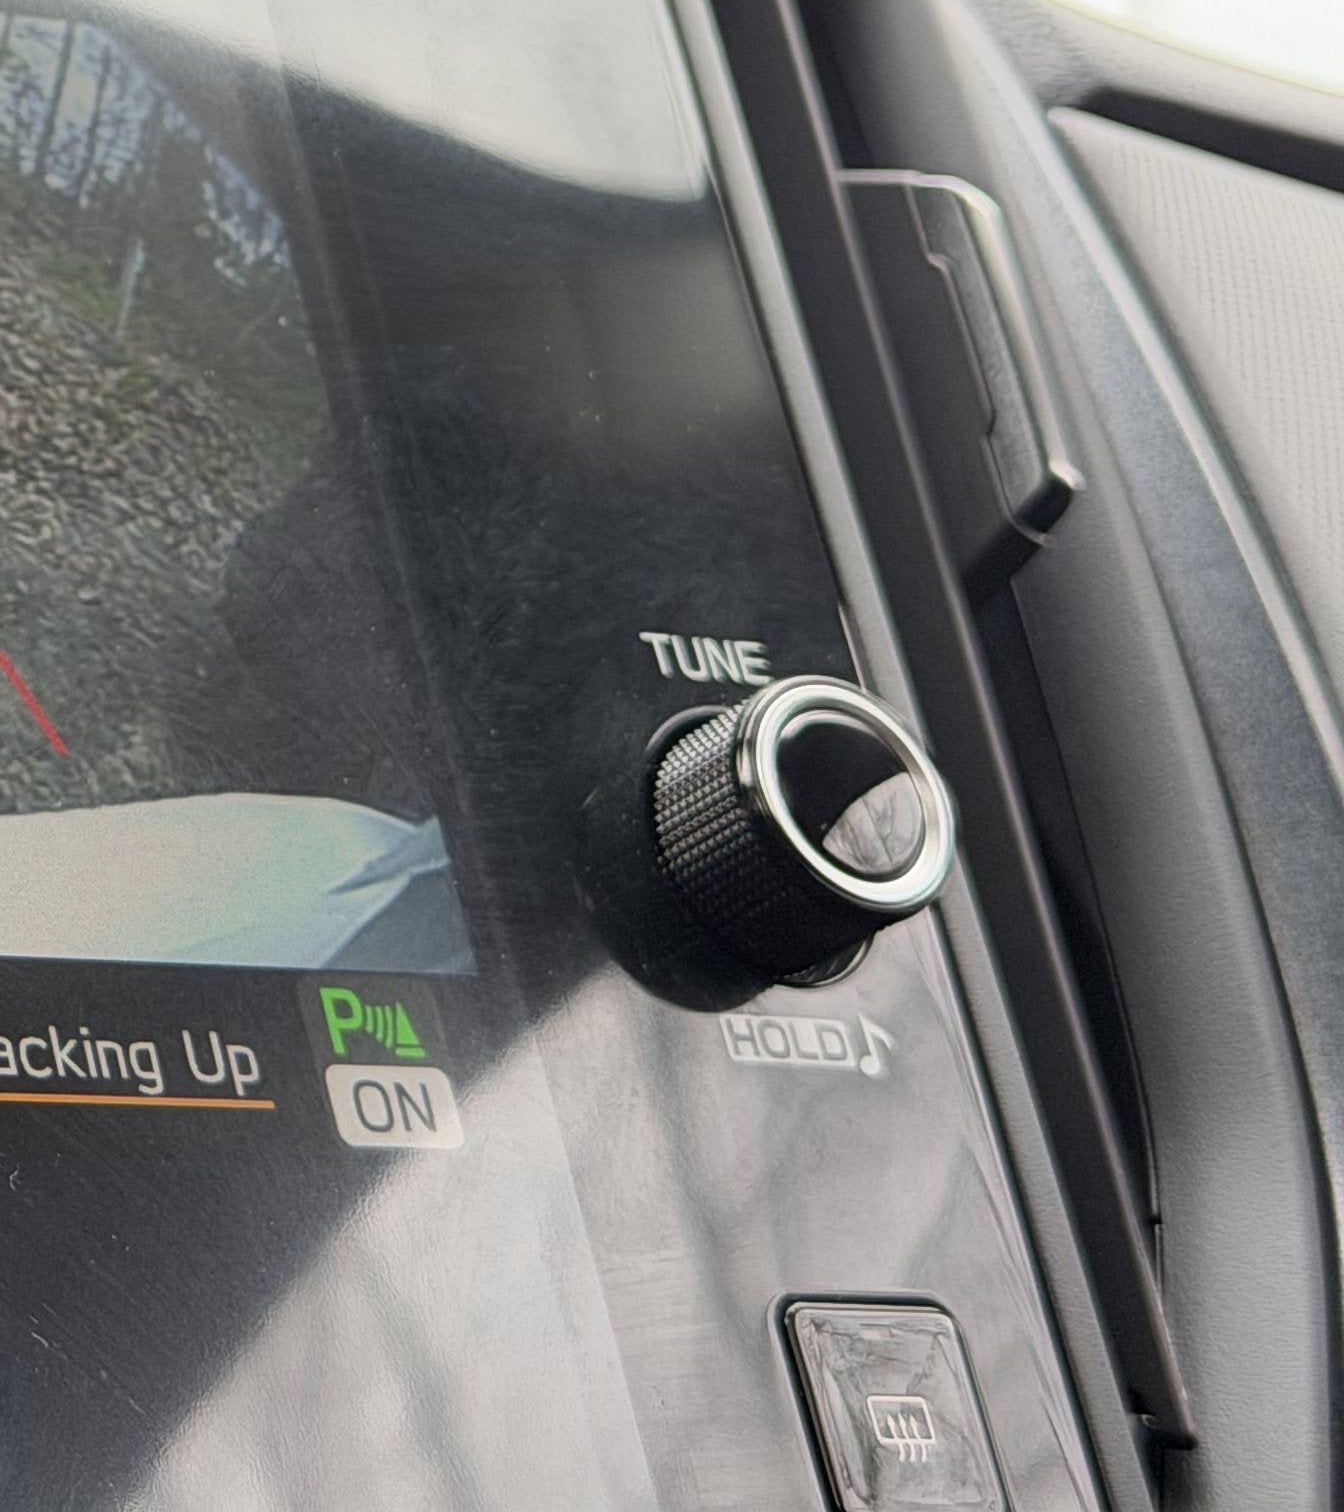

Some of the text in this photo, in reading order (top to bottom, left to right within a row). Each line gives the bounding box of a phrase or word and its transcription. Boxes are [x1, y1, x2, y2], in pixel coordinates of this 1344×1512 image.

[639, 631, 774, 686] TUNE
[181, 1029, 261, 1096] Up
[725, 1019, 852, 1063] HOLD
[351, 1078, 438, 1134] ON
